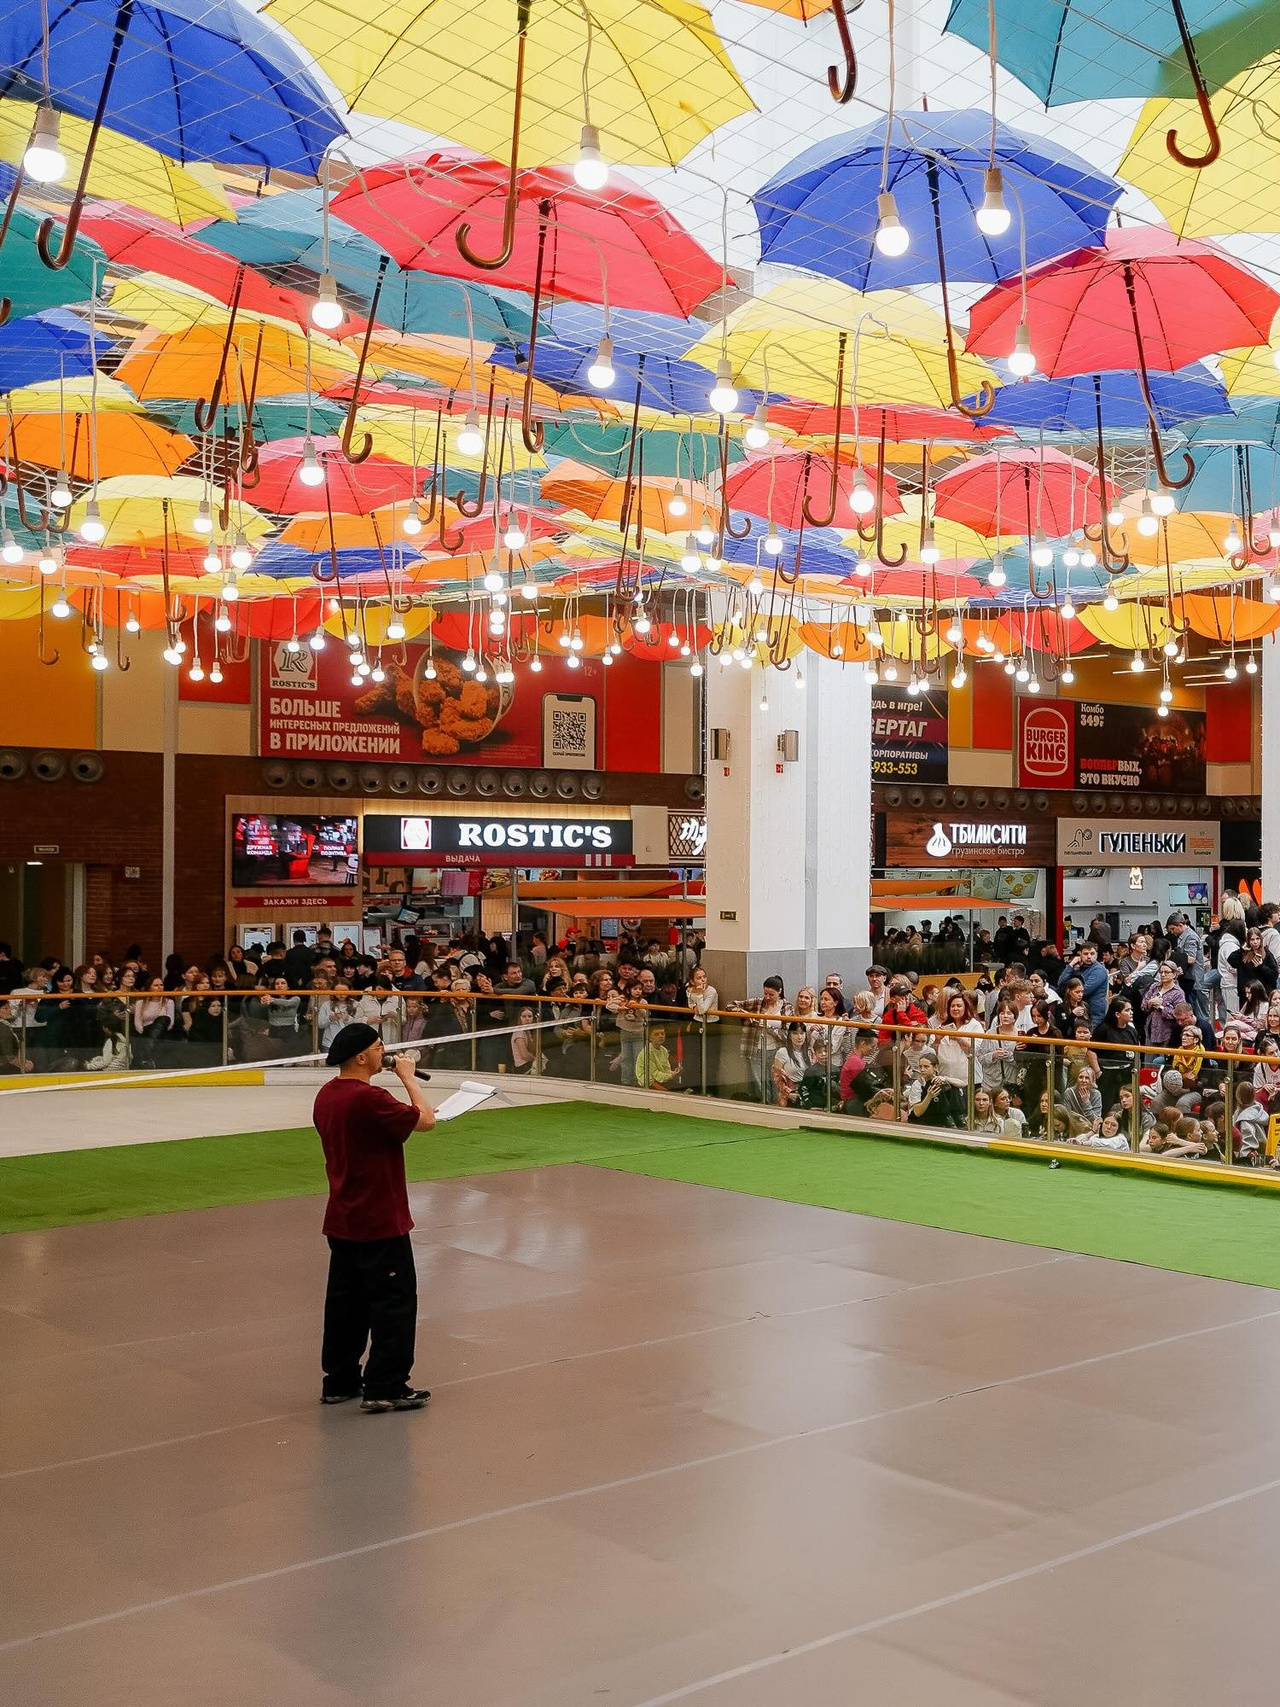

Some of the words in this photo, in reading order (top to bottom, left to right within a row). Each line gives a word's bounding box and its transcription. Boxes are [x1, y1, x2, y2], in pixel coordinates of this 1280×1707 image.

[271, 680, 316, 689] ROSTIC'S
[269, 697, 342, 718] БОЛЬШЕ
[898, 701, 923, 712] игре!
[1080, 703, 1105, 714] Комбо
[269, 719, 331, 732] ИНТЕРЕСНЫХ
[332, 722, 400, 735] ПРЕДЛОЖЕНИЙ
[270, 732, 281, 750] В
[285, 733, 400, 755] ПРИЛОЖЕНИИ
[1026, 728, 1067, 744] BURGER
[871, 749, 929, 760] ОРПОРАТИВЫ
[1026, 742, 1067, 762] KING
[1079, 772, 1100, 785] ЭТО
[1101, 774, 1140, 786] ВКУСНО
[458, 823, 613, 848] ROSTIC'S
[949, 823, 1027, 845] ТБИЛИСИТИ
[1098, 831, 1187, 854] ГУЛЕНЬКИ
[445, 855, 481, 863] ВЫДАЧА
[951, 847, 996, 857] грузинское
[997, 845, 1025, 858] бистро
[263, 898, 299, 906] ЗАКАЖИ
